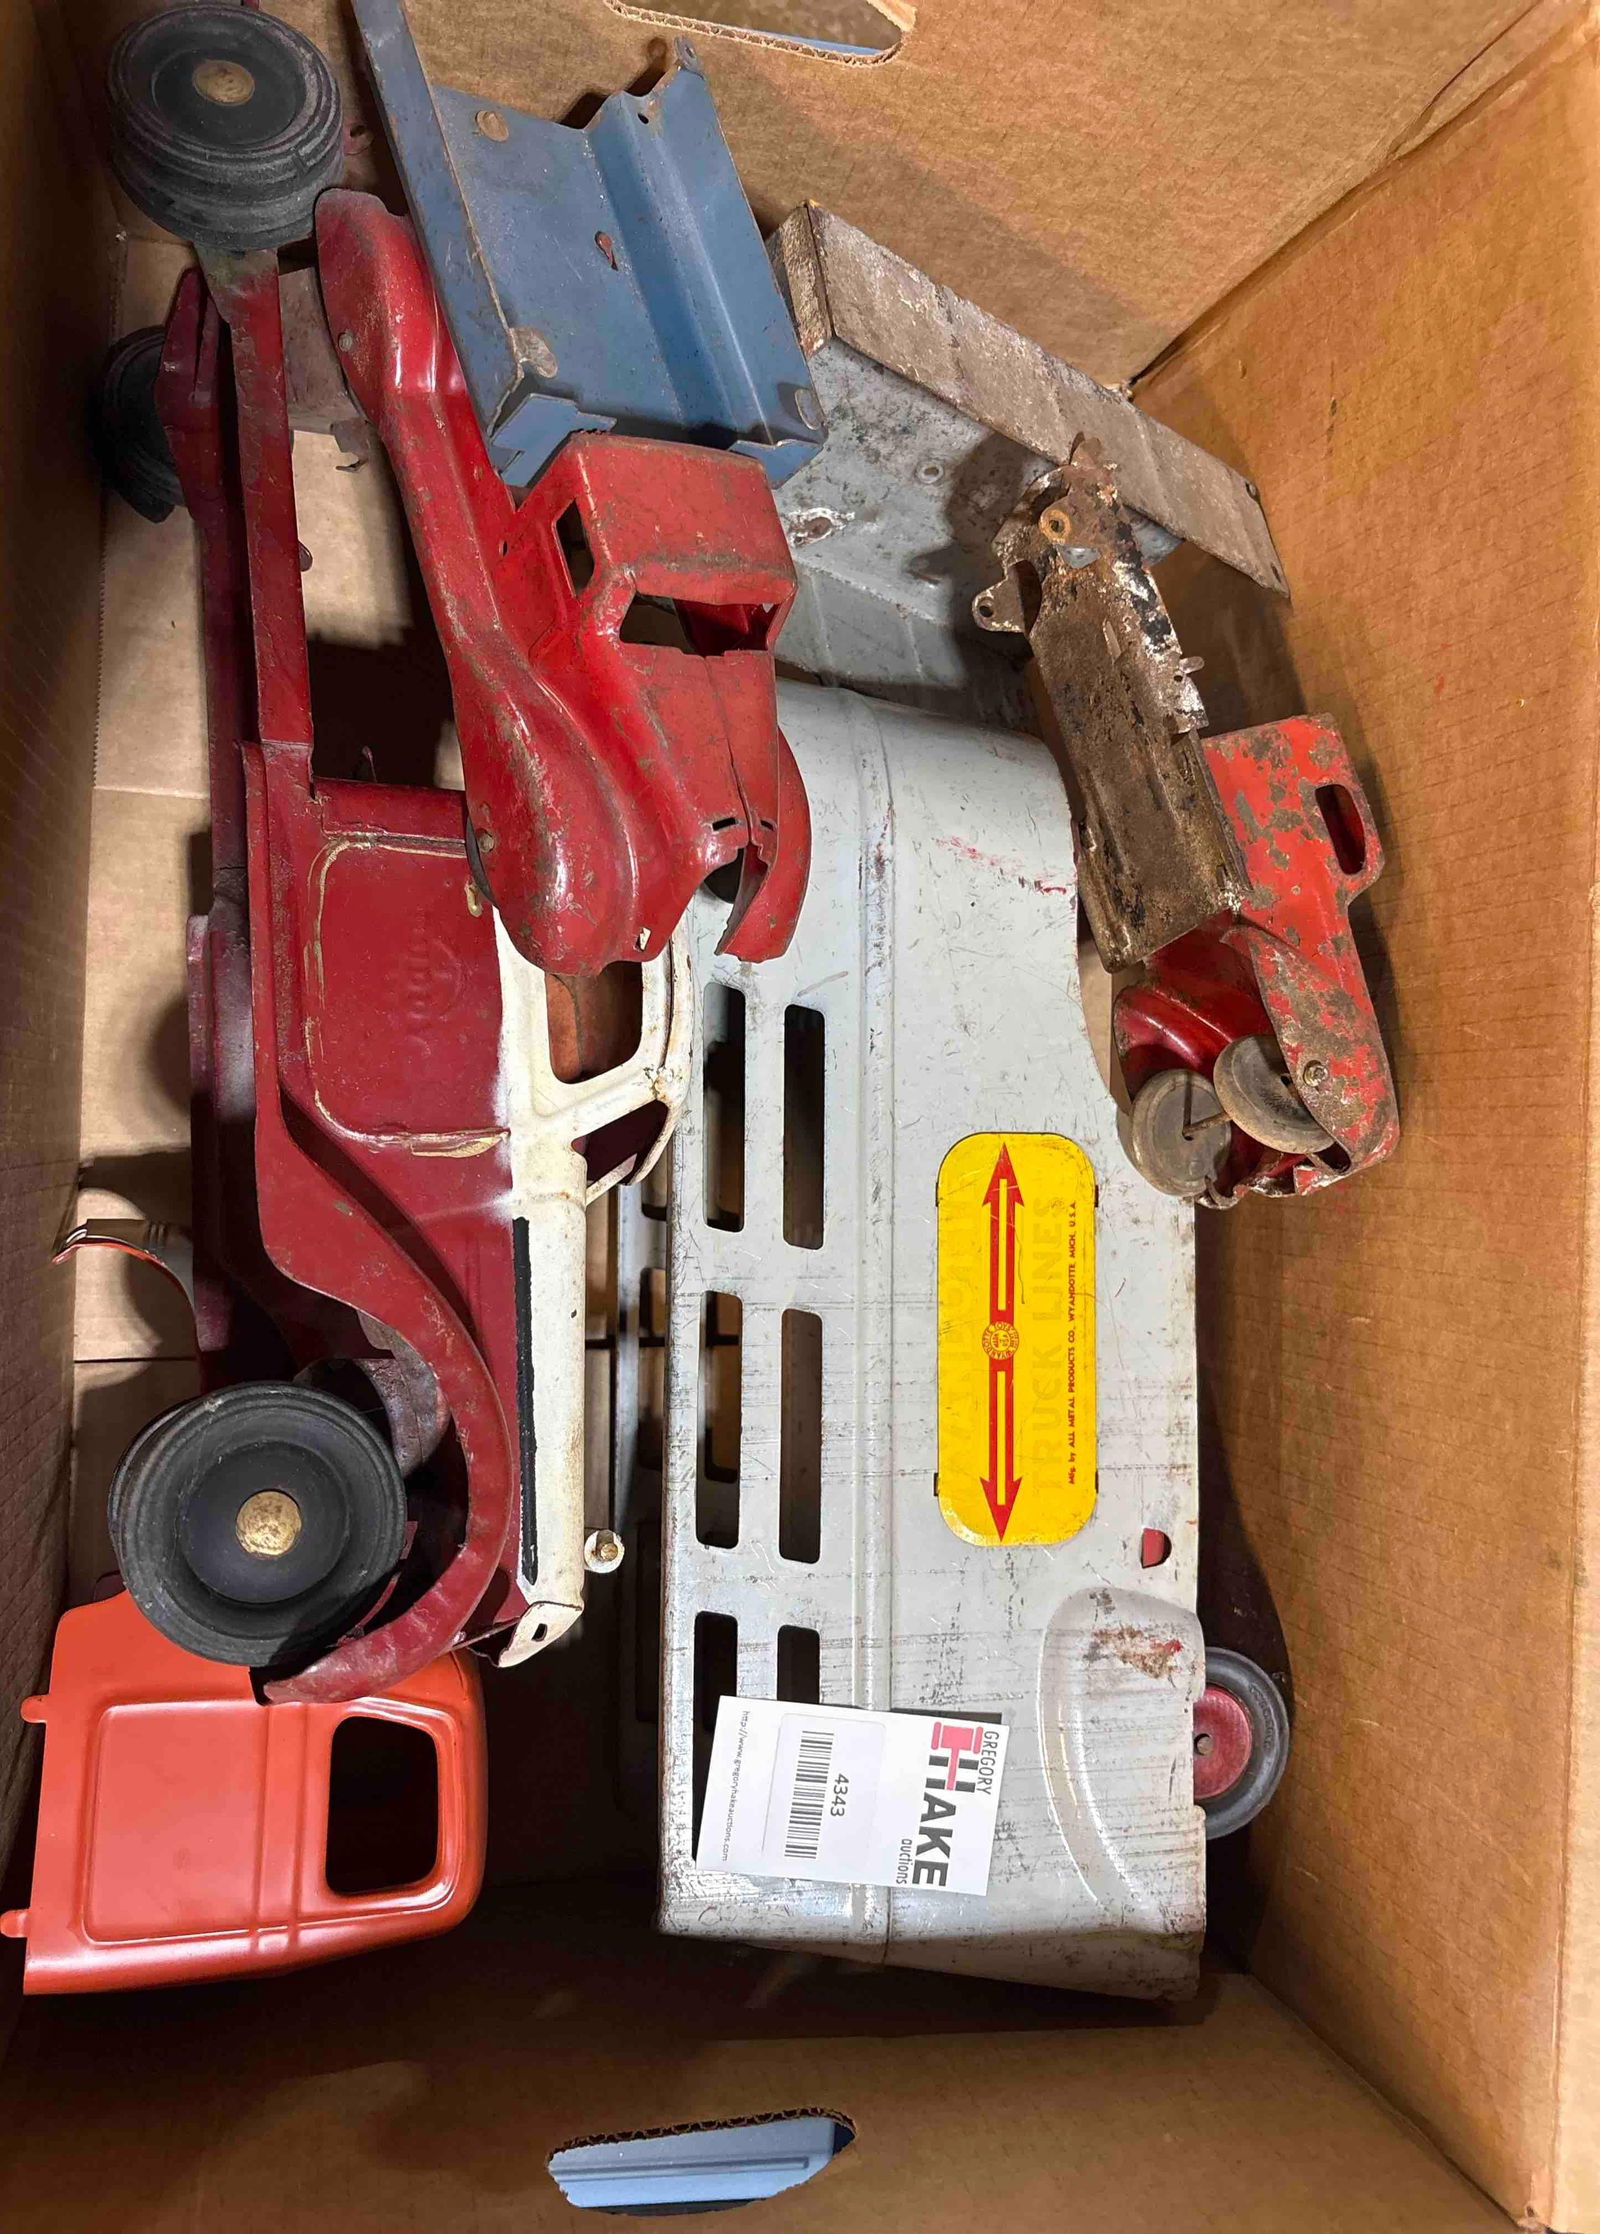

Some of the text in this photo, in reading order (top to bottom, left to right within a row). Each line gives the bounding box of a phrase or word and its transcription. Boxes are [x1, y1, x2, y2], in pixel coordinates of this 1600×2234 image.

[1032, 1196, 1063, 1498] TRUCK LINES
[1067, 1347, 1076, 1393] PRODUCTS
[1067, 1397, 1076, 1428] METAL
[1067, 1431, 1076, 1448] ALL
[1067, 1452, 1076, 1463] by
[720, 1710, 751, 1862] http://www.gregoryhakeauctions.com
[975, 1730, 1000, 1796] GREGORY
[830, 1773, 850, 1818] 4343
[911, 1754, 979, 1887] HAKE
[895, 1838, 914, 1885] auctions
